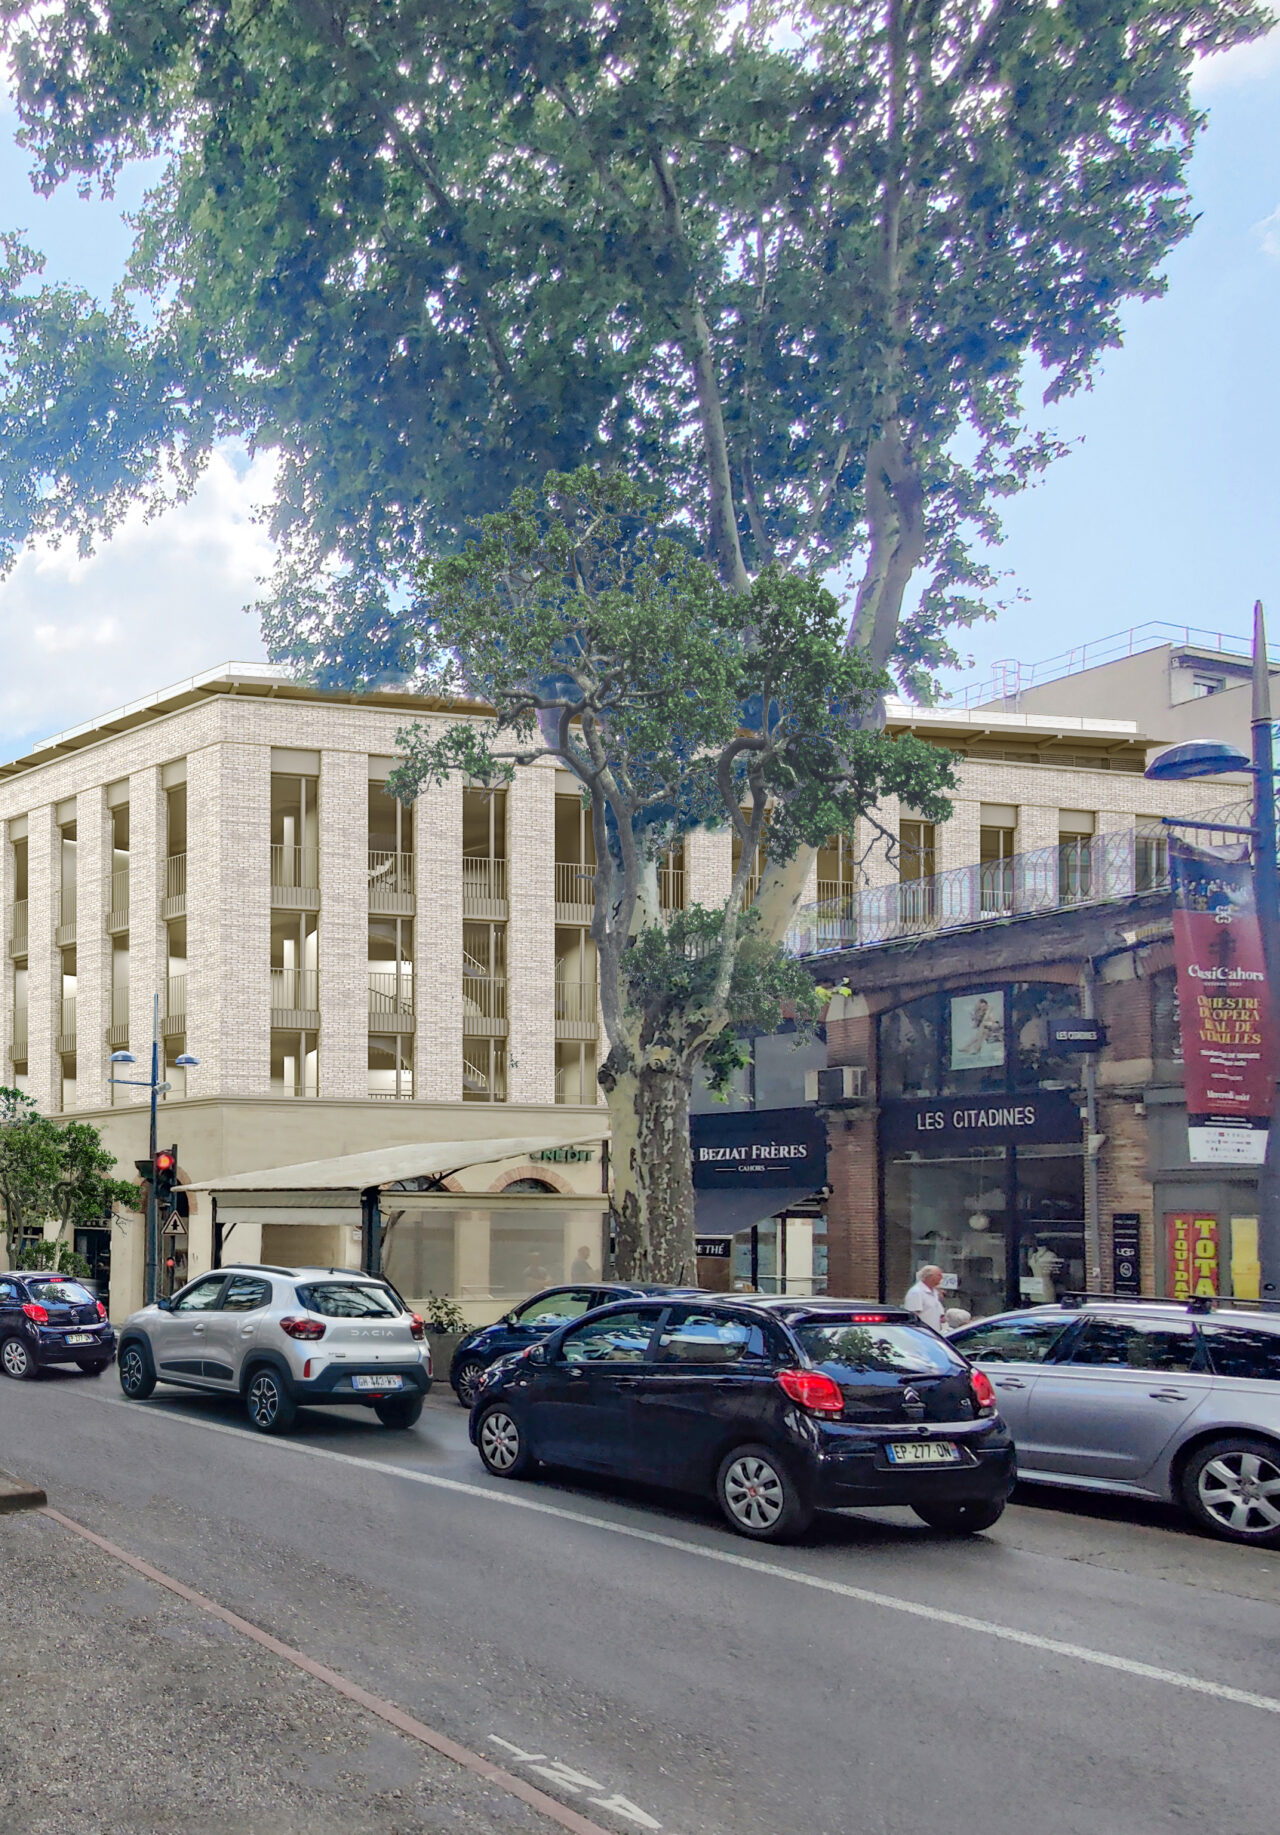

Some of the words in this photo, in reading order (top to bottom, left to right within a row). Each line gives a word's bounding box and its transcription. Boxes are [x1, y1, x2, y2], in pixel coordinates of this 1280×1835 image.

[1188, 964, 1264, 981] CsiCahors
[1197, 995, 1260, 1009] OHESTRE
[917, 1112, 945, 1130] LES
[953, 1106, 1036, 1128] CITADINES
[700, 1147, 748, 1160] BEZIAT
[751, 1141, 807, 1159] FRÈRES
[705, 1242, 725, 1254] THÉ
